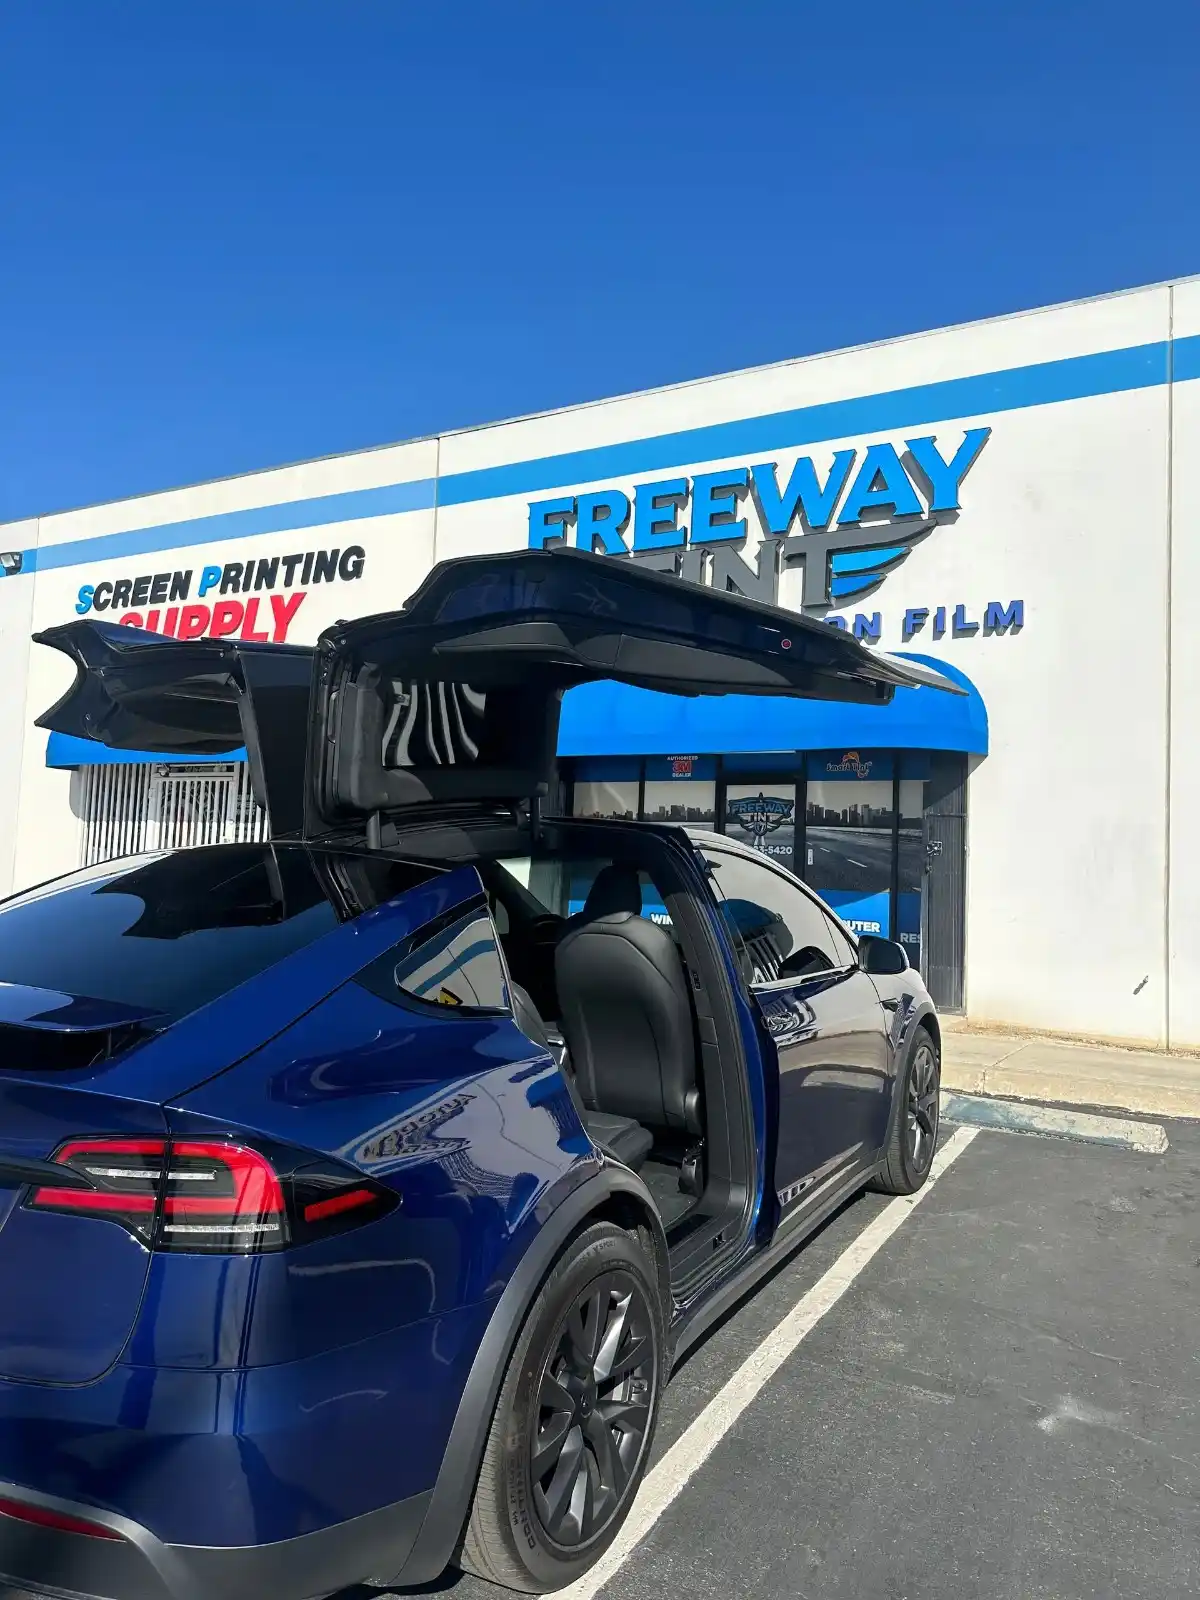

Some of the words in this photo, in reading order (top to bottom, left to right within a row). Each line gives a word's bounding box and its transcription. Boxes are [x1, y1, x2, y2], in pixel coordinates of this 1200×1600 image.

[527, 427, 991, 556] FREEWAY
[75, 570, 193, 614] SCREEN
[198, 545, 366, 597] PRINTING
[616, 523, 908, 609] NT
[905, 599, 1024, 634] FILM
[672, 760, 692, 772] 3M
[731, 801, 790, 817] FREEWAY
